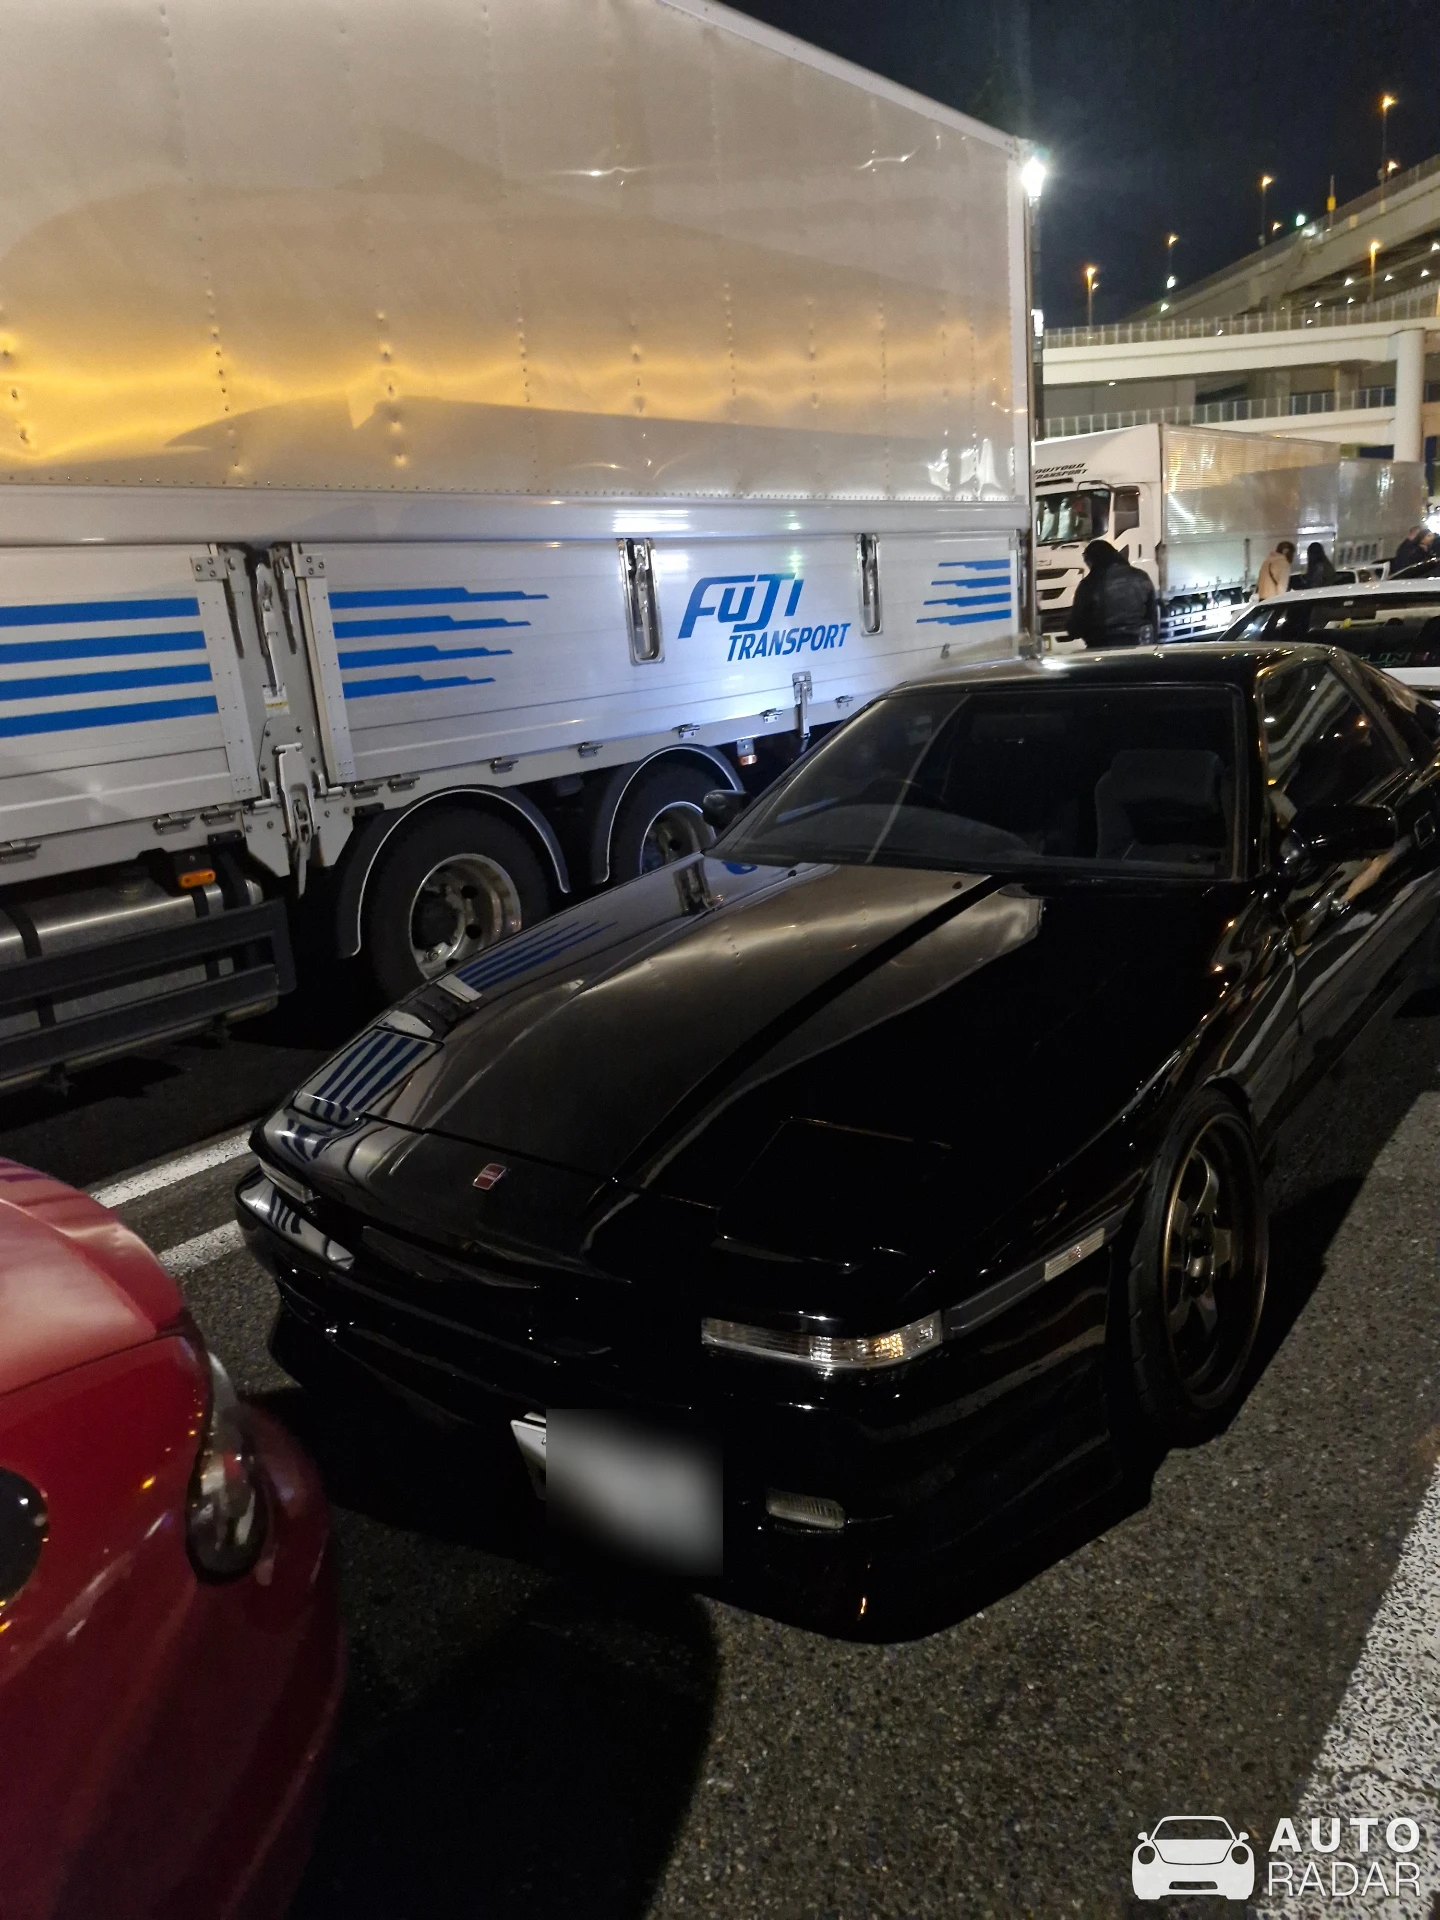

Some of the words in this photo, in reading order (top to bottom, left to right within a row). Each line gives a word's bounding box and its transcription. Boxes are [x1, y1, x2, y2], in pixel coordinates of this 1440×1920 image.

[1034, 469, 1088, 480] RANSPORT
[677, 572, 804, 639] FUJI
[726, 622, 851, 662] TRANSPORT
